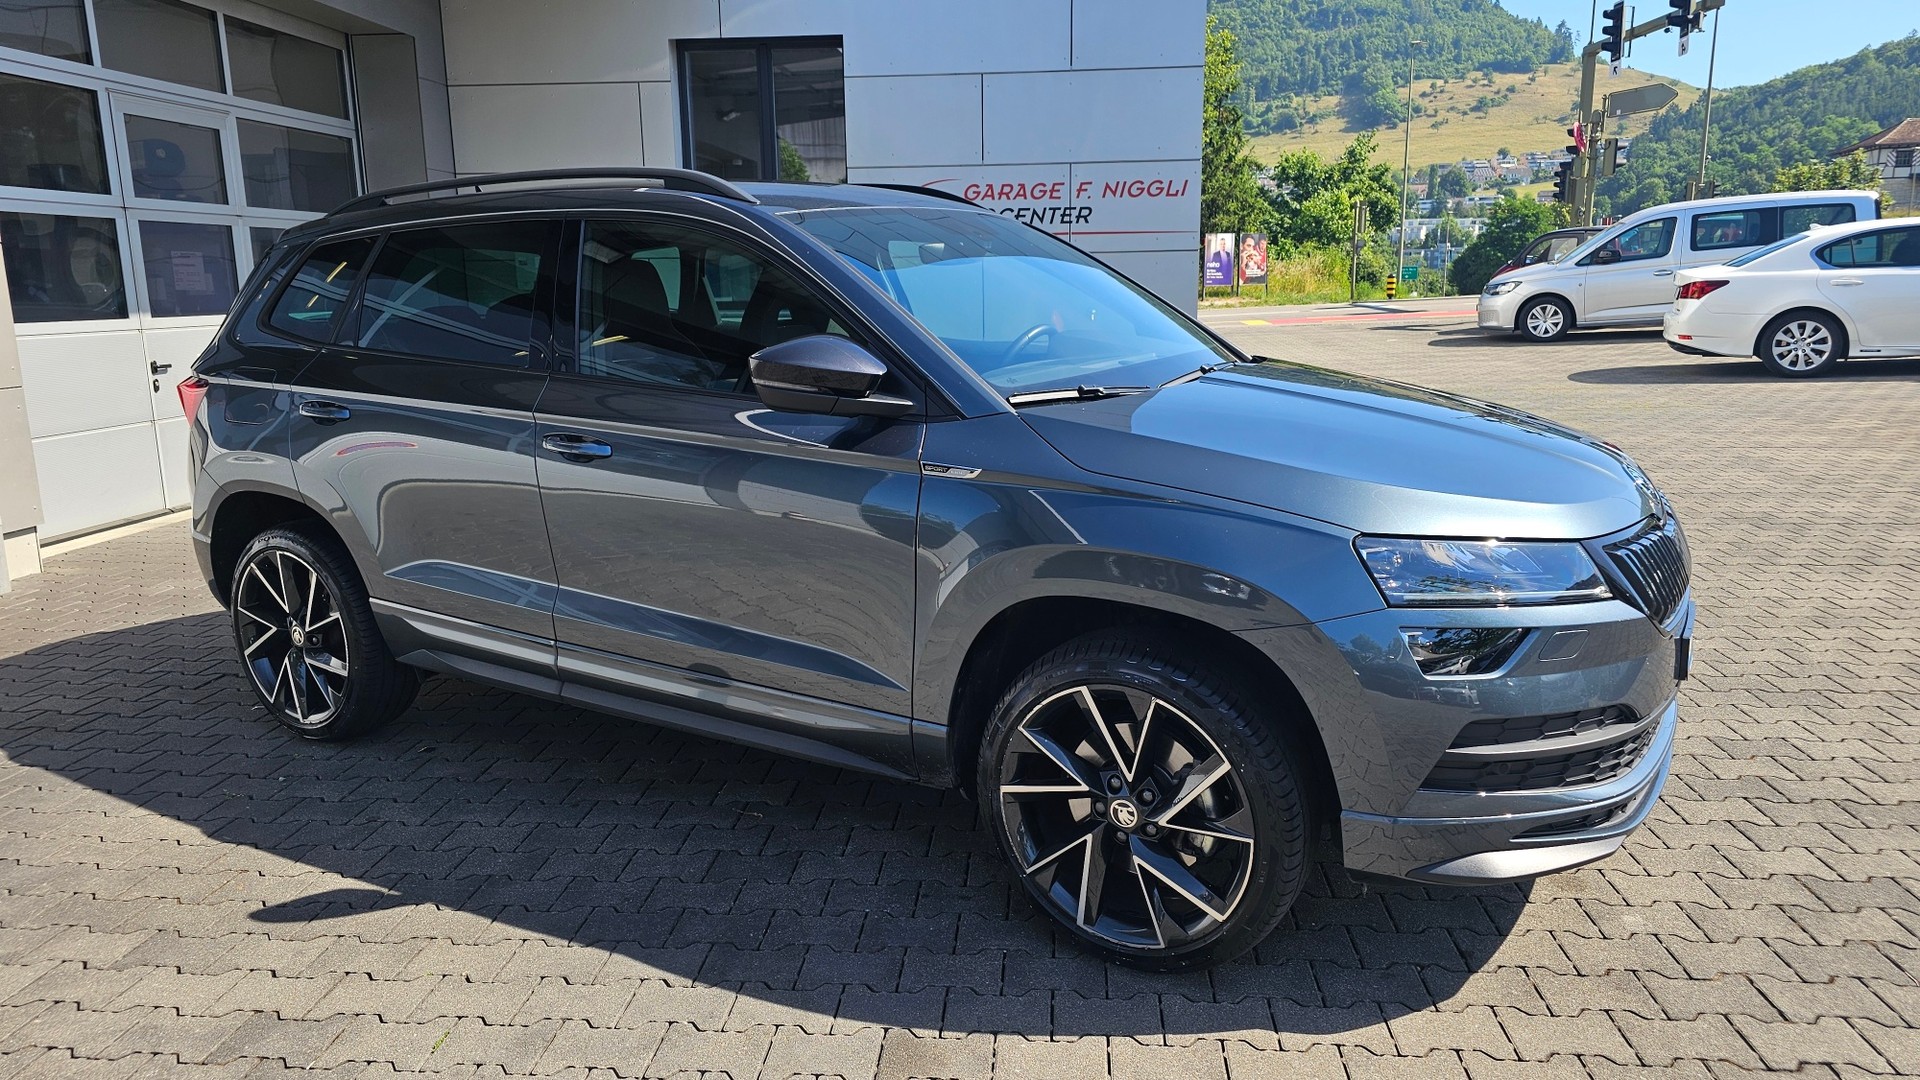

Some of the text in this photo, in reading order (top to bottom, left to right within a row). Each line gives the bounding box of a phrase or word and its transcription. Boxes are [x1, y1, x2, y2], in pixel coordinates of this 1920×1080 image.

[964, 179, 1189, 201] GARAGE F. NIGGLI
[988, 206, 1093, 224] ENTER
